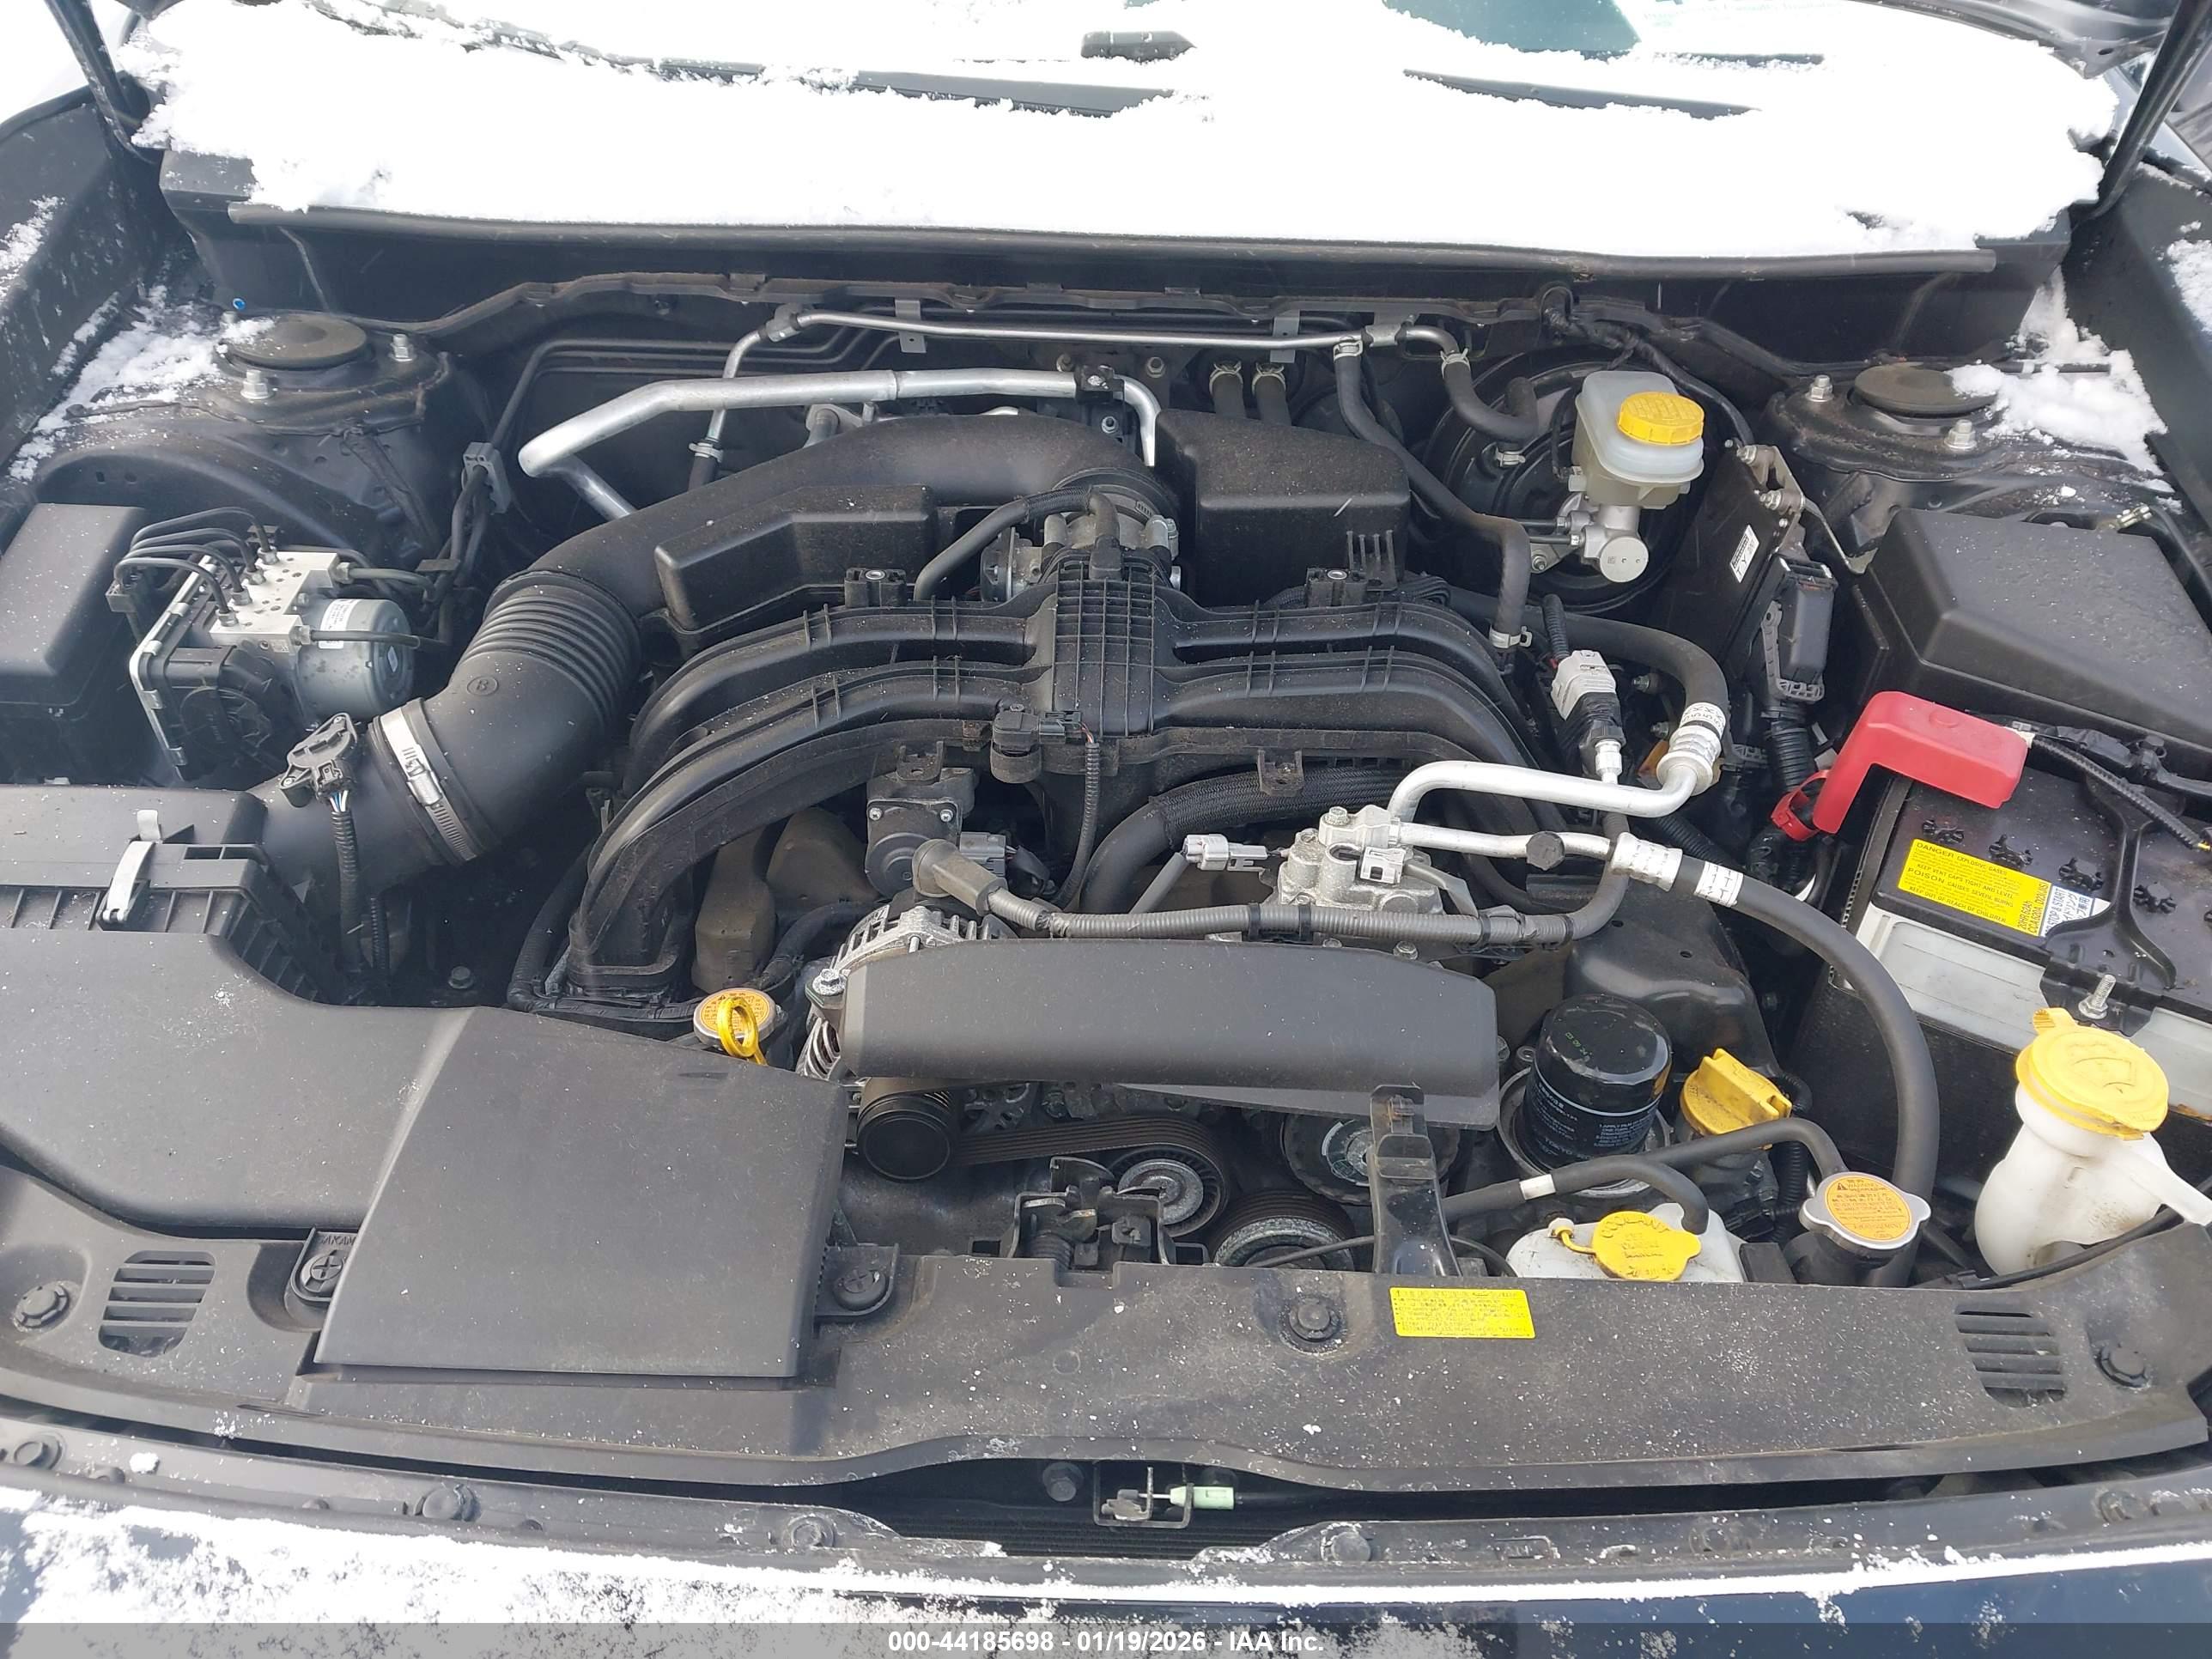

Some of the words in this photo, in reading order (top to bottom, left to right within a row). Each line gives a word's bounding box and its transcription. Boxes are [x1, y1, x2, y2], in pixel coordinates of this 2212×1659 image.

[1916, 842, 1954, 858] DANGER
[1907, 867, 1944, 883] POISON
[1946, 898, 1966, 908] REACH
[2051, 888, 2067, 906] START
